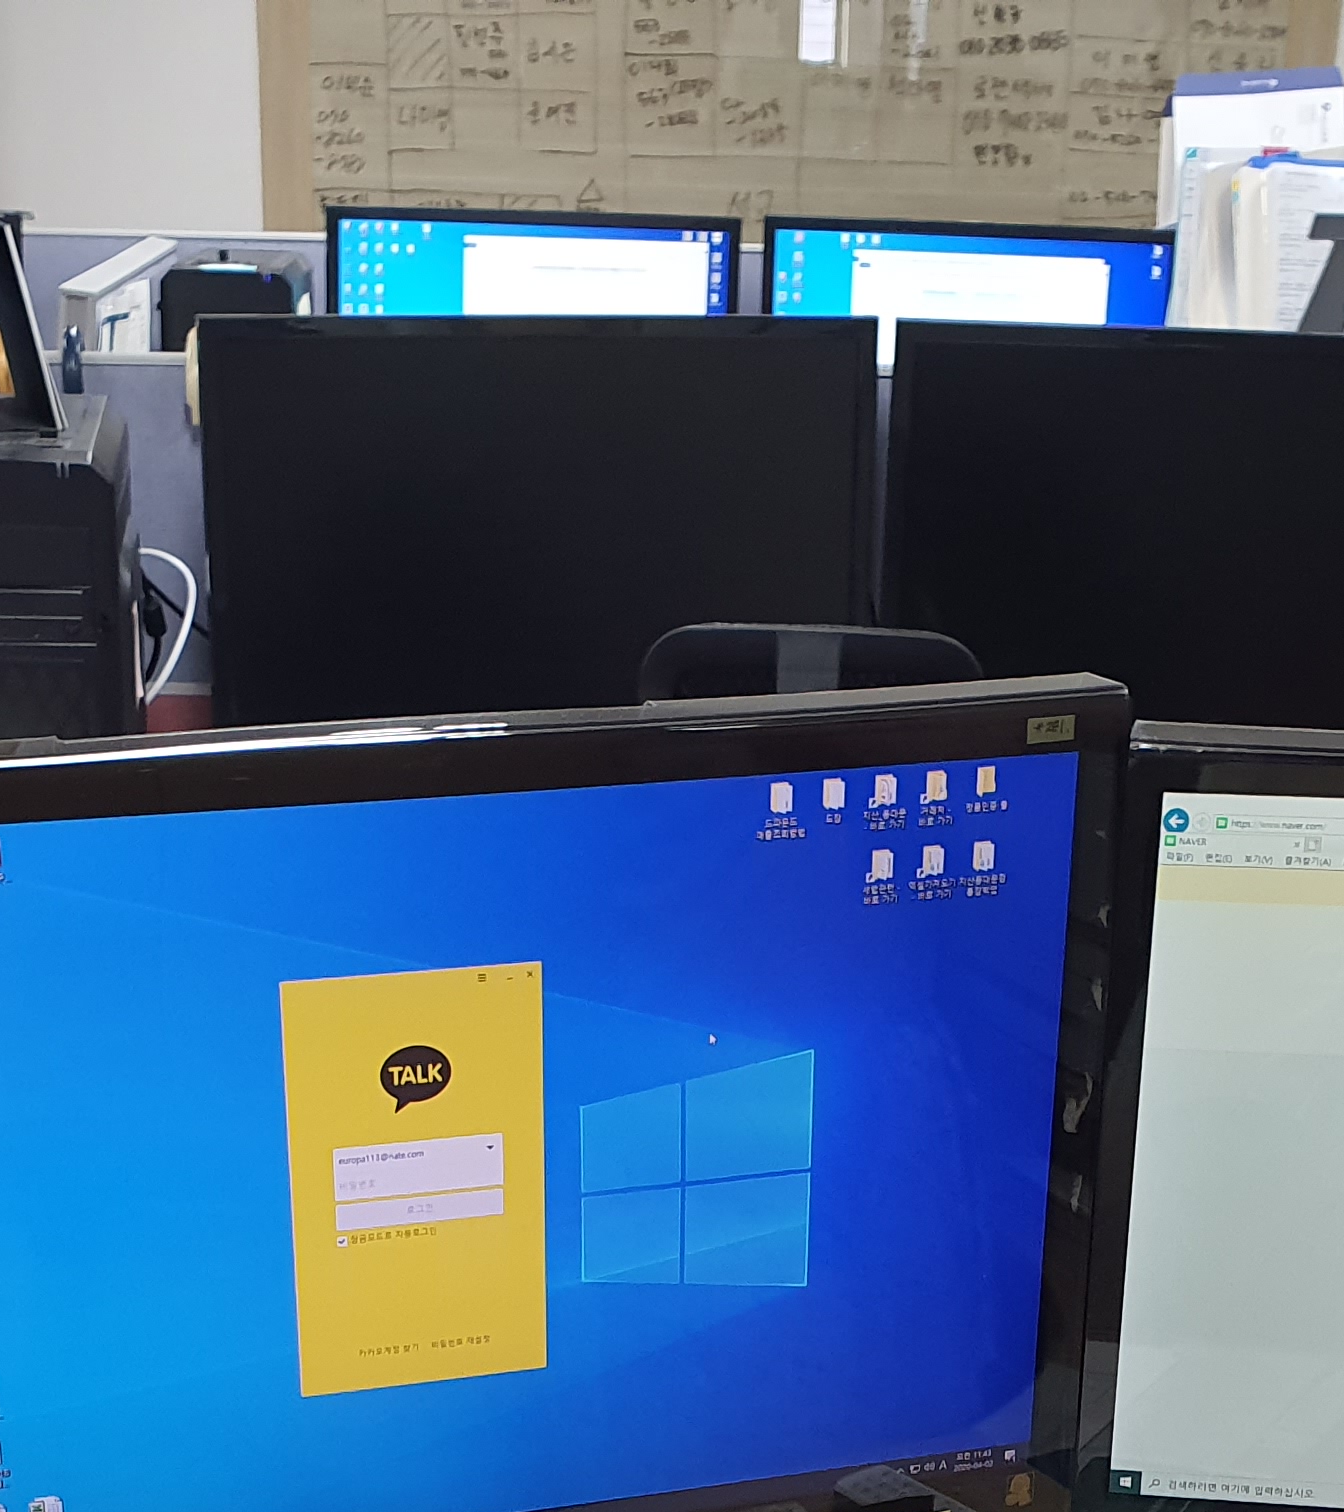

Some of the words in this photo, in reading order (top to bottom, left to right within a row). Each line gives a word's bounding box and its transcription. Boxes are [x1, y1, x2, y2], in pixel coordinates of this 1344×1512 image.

[388, 1062, 444, 1087] TALK
[1169, 1480, 1217, 1493] 검색하려면
[1221, 1484, 1250, 1495] 여기에
[1255, 1486, 1314, 1499] 입력하십시오
